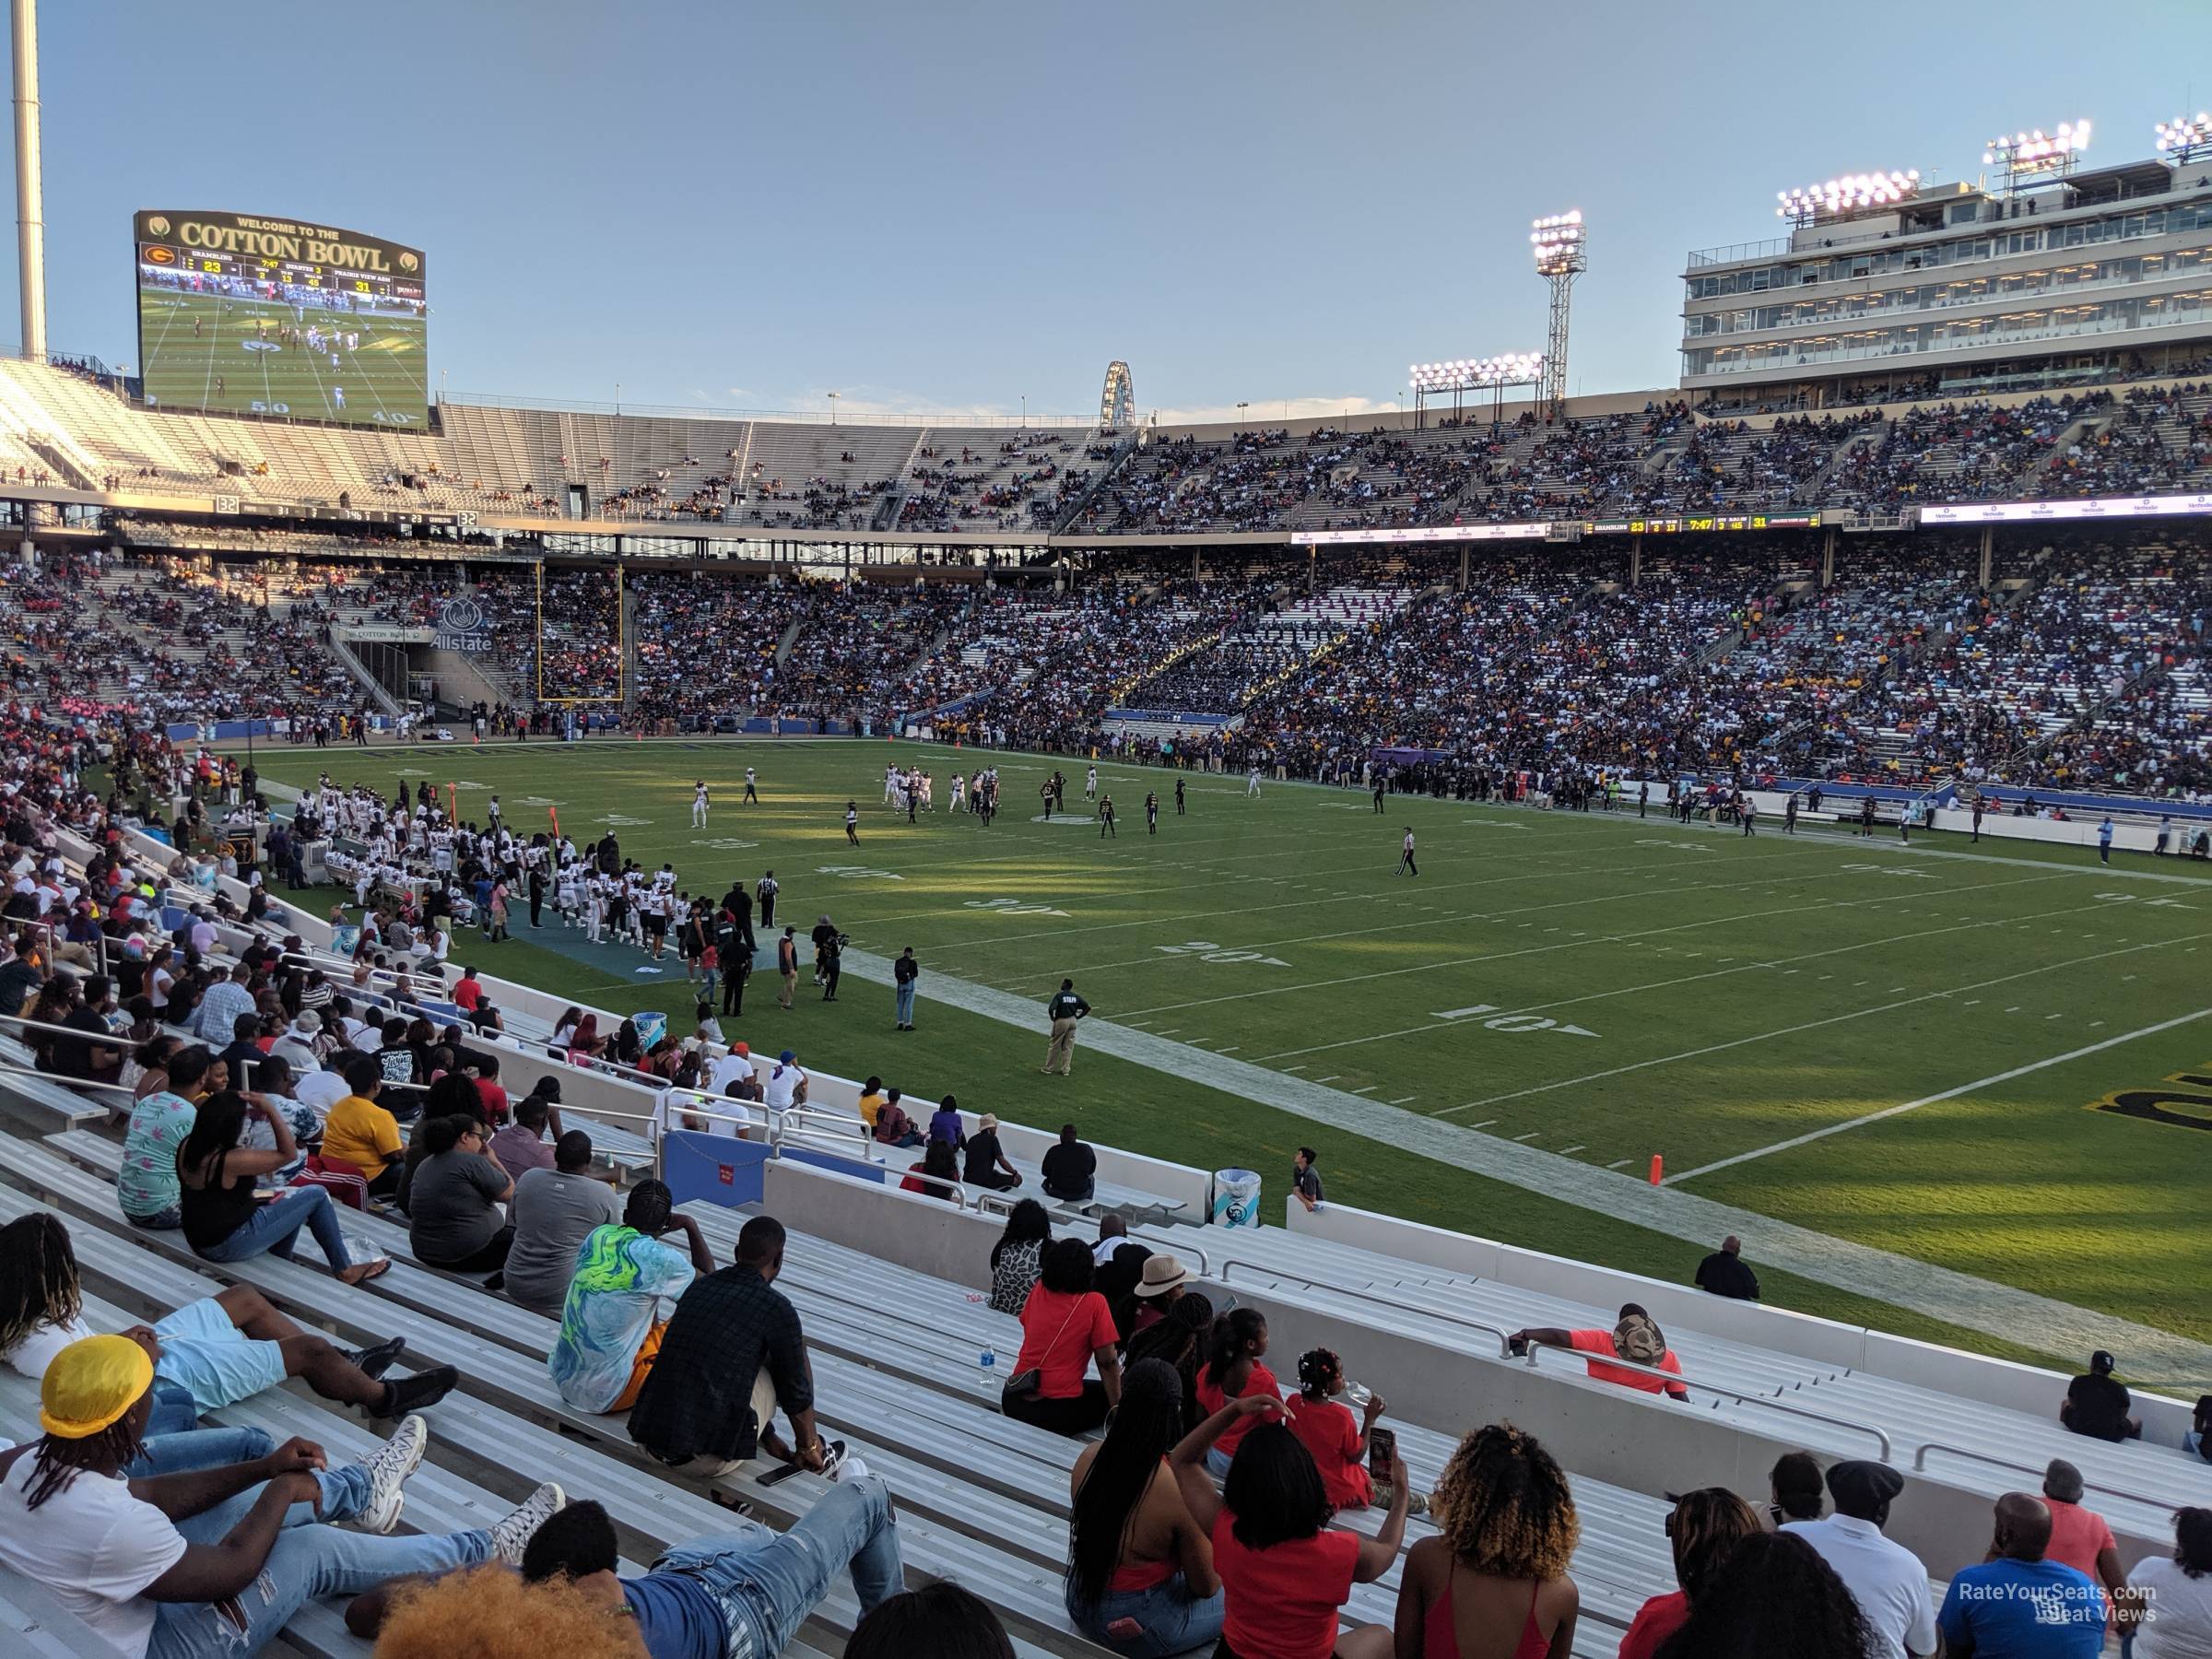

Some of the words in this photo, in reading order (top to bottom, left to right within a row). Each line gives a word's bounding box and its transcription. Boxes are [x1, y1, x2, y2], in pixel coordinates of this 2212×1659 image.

[237, 218, 296, 234] WELCOME
[299, 226, 314, 237] TO
[317, 229, 340, 241] THE
[180, 222, 302, 260] COTTON
[307, 240, 390, 272] BOWL
[192, 250, 233, 262] GRAMBLING
[203, 261, 221, 273] 23
[262, 259, 278, 268] 7:47
[286, 263, 313, 273] QUARTER
[334, 270, 359, 278] PRAIRIE
[355, 281, 371, 292] 31
[220, 498, 237, 511] 32
[277, 506, 288, 515] 31
[411, 514, 422, 523] 23
[461, 512, 476, 525] 32
[1753, 517, 1767, 527] 31
[1630, 522, 1644, 532] 23
[1689, 519, 1712, 530] 7:47
[430, 634, 492, 651] Allstate
[559, 875, 570, 884] 55
[1429, 1005, 1558, 1032] 10
